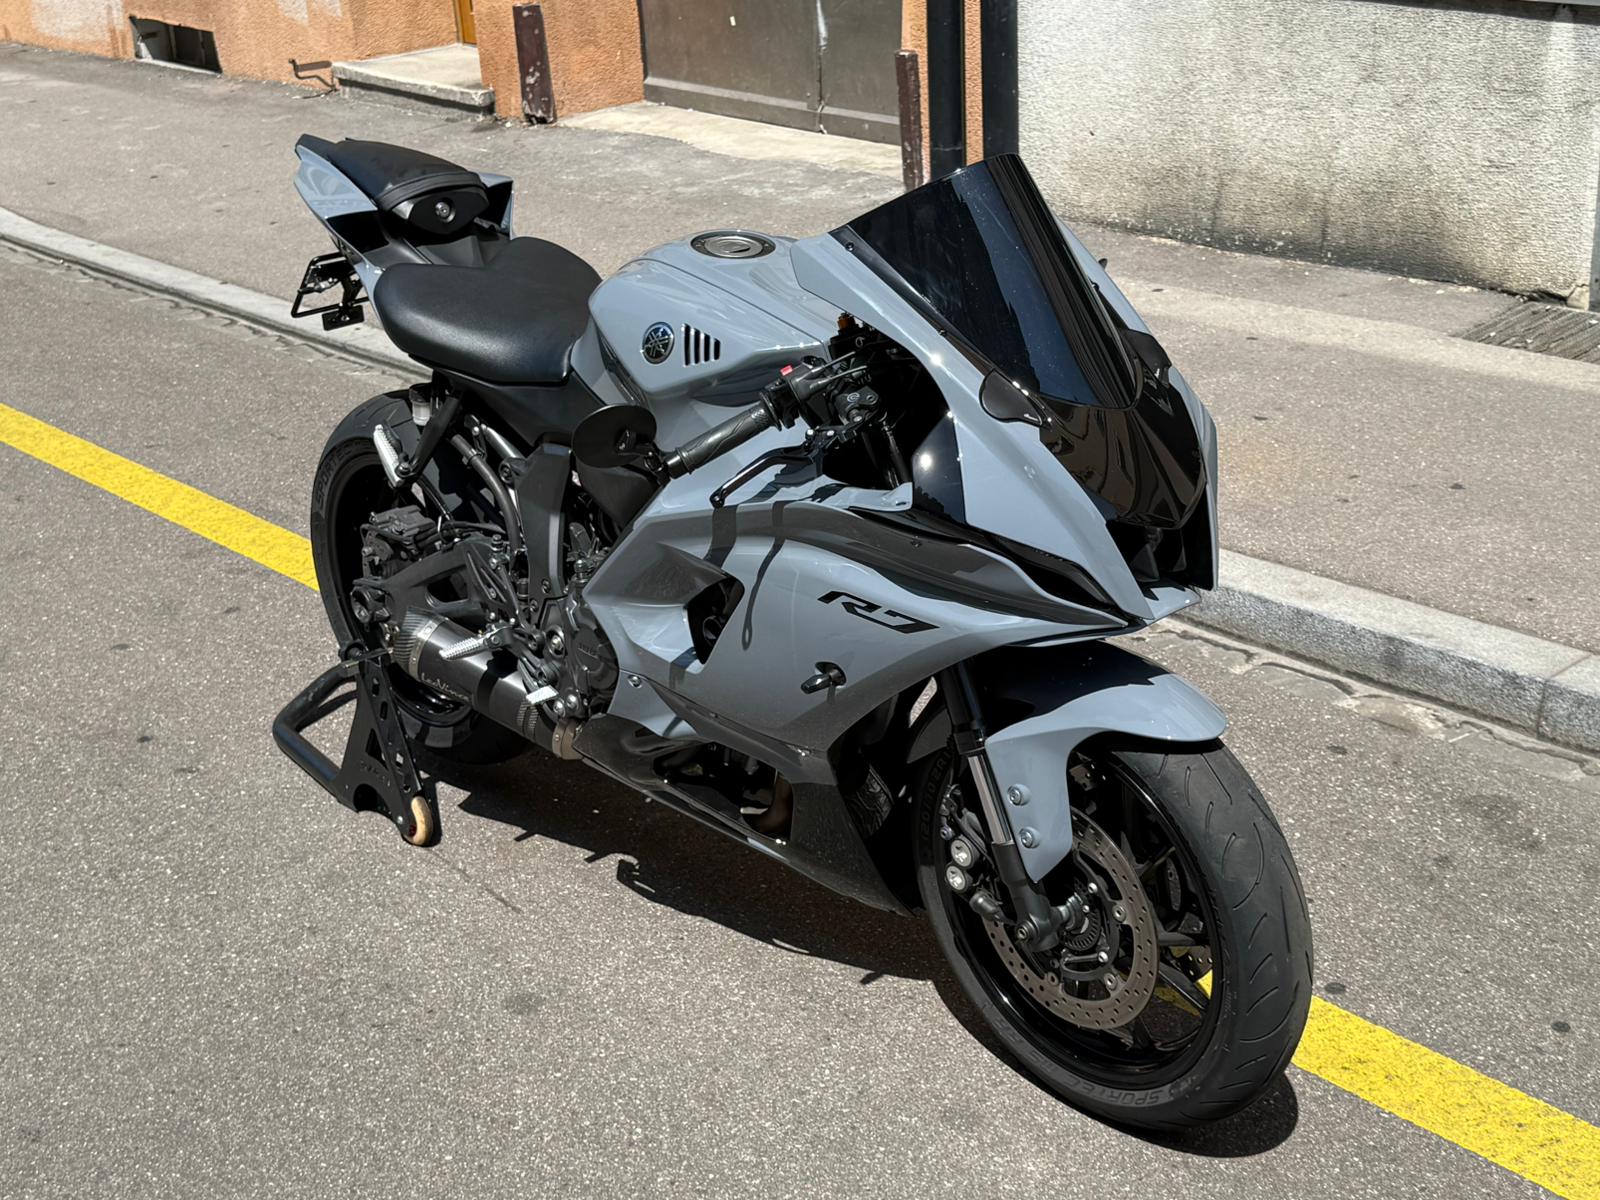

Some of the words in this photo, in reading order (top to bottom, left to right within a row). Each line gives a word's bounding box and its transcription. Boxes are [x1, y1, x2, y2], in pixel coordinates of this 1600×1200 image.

[316, 443, 352, 508] SPORTEC
[817, 590, 940, 634] R7
[1063, 1074, 1163, 1106] SPORTEC
